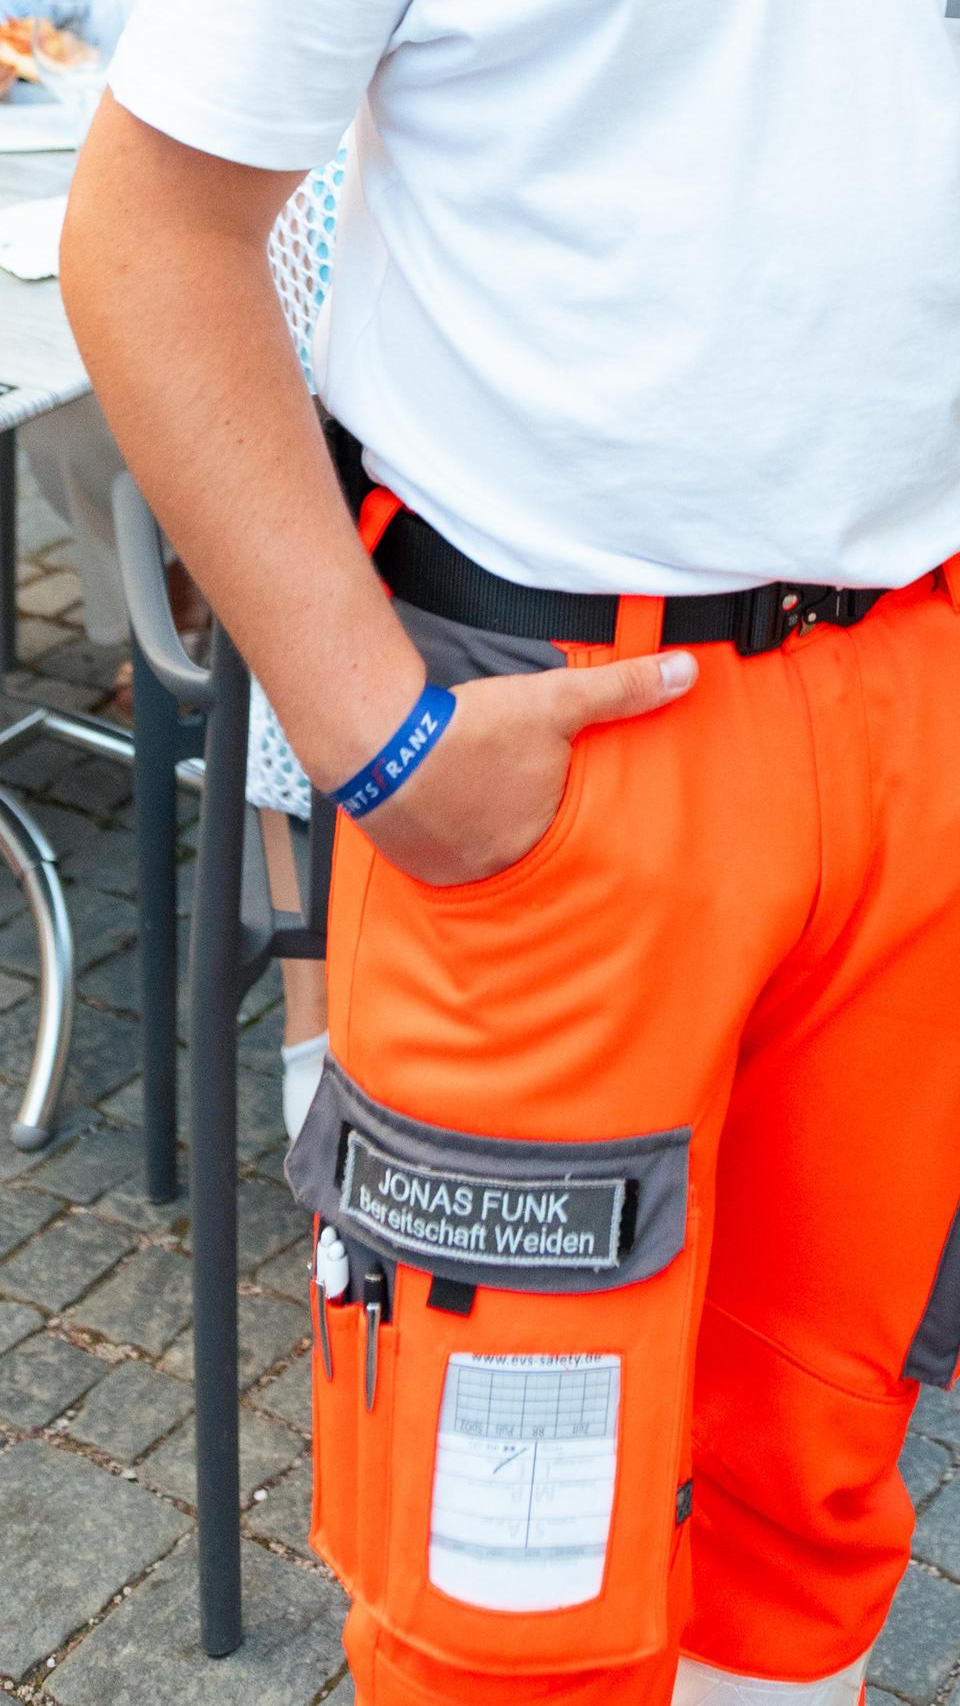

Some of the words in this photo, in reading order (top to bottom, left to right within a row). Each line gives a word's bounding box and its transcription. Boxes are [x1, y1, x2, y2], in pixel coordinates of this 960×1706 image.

[359, 1186, 486, 1250] Bereitschaft
[494, 1225, 595, 1255] Weiden
[378, 1167, 473, 1216] JONAS
[481, 1190, 569, 1223] FUNK
